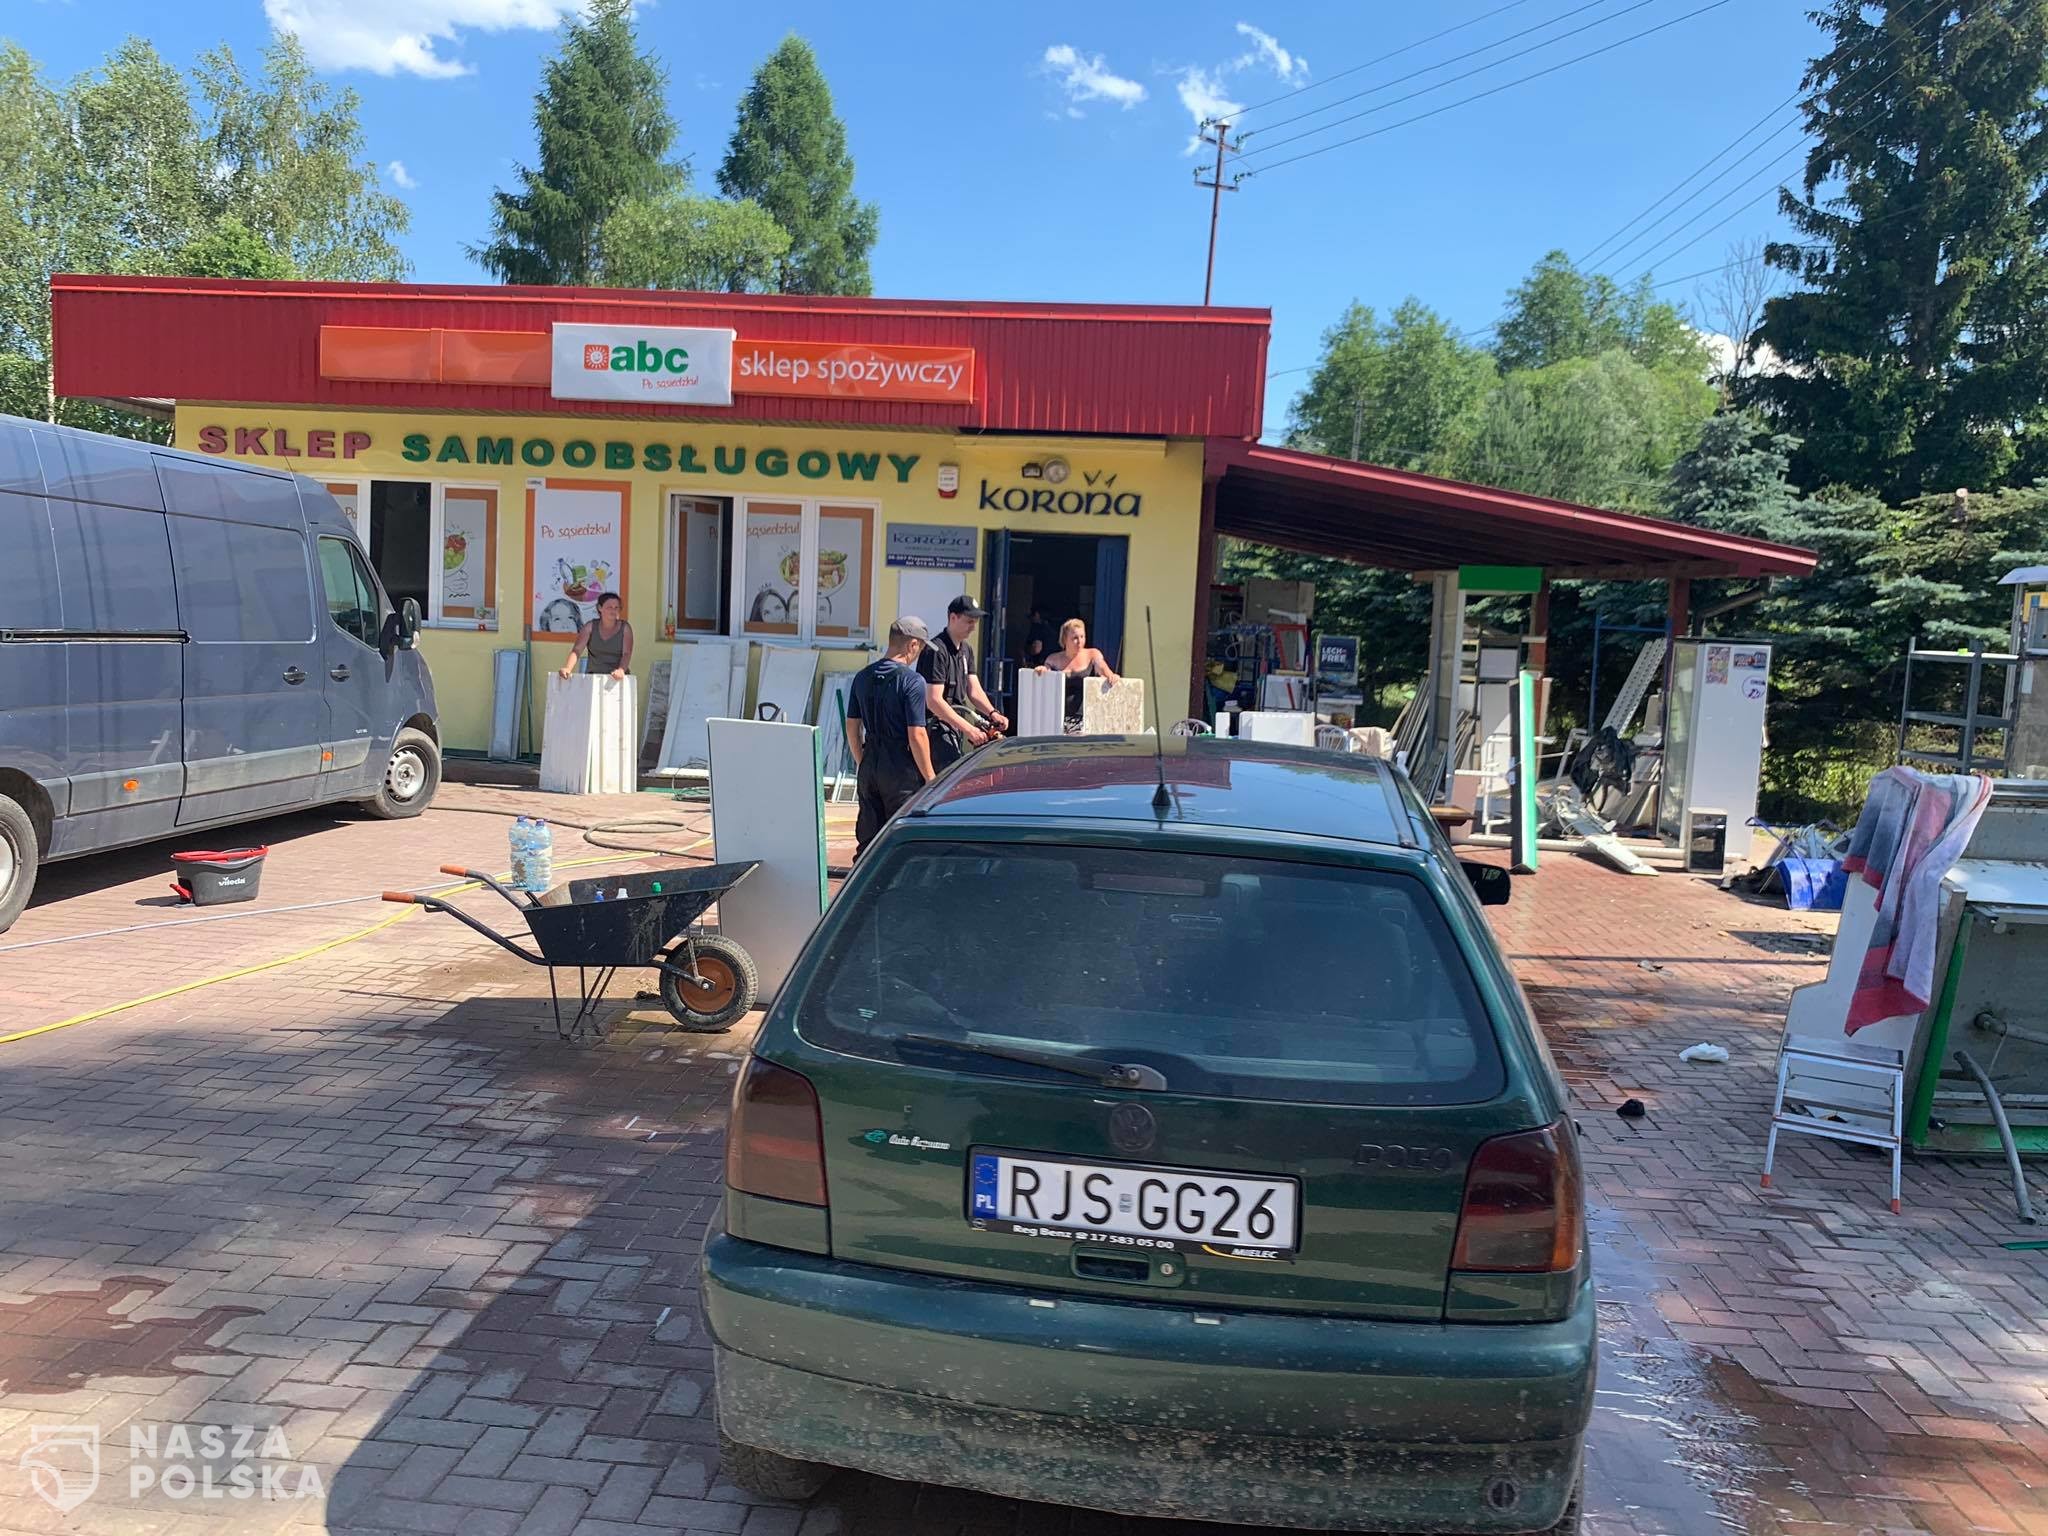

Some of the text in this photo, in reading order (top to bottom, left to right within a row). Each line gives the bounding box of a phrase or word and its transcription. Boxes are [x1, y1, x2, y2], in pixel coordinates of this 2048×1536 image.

[611, 341, 689, 374] abc
[740, 350, 964, 391] sklep spożywczy
[198, 426, 372, 459] SKLEP
[402, 433, 921, 483] SAMOOBSŁUGOWY
[541, 522, 612, 540] Po sąsiedzku!
[1321, 654, 1346, 663] FREE
[975, 1194, 996, 1210] PL
[1009, 1165, 1277, 1240] RJS GG26
[1013, 1224, 1175, 1249] Reg Benz 17 583 05 00
[1231, 1248, 1278, 1260] MIELEC
